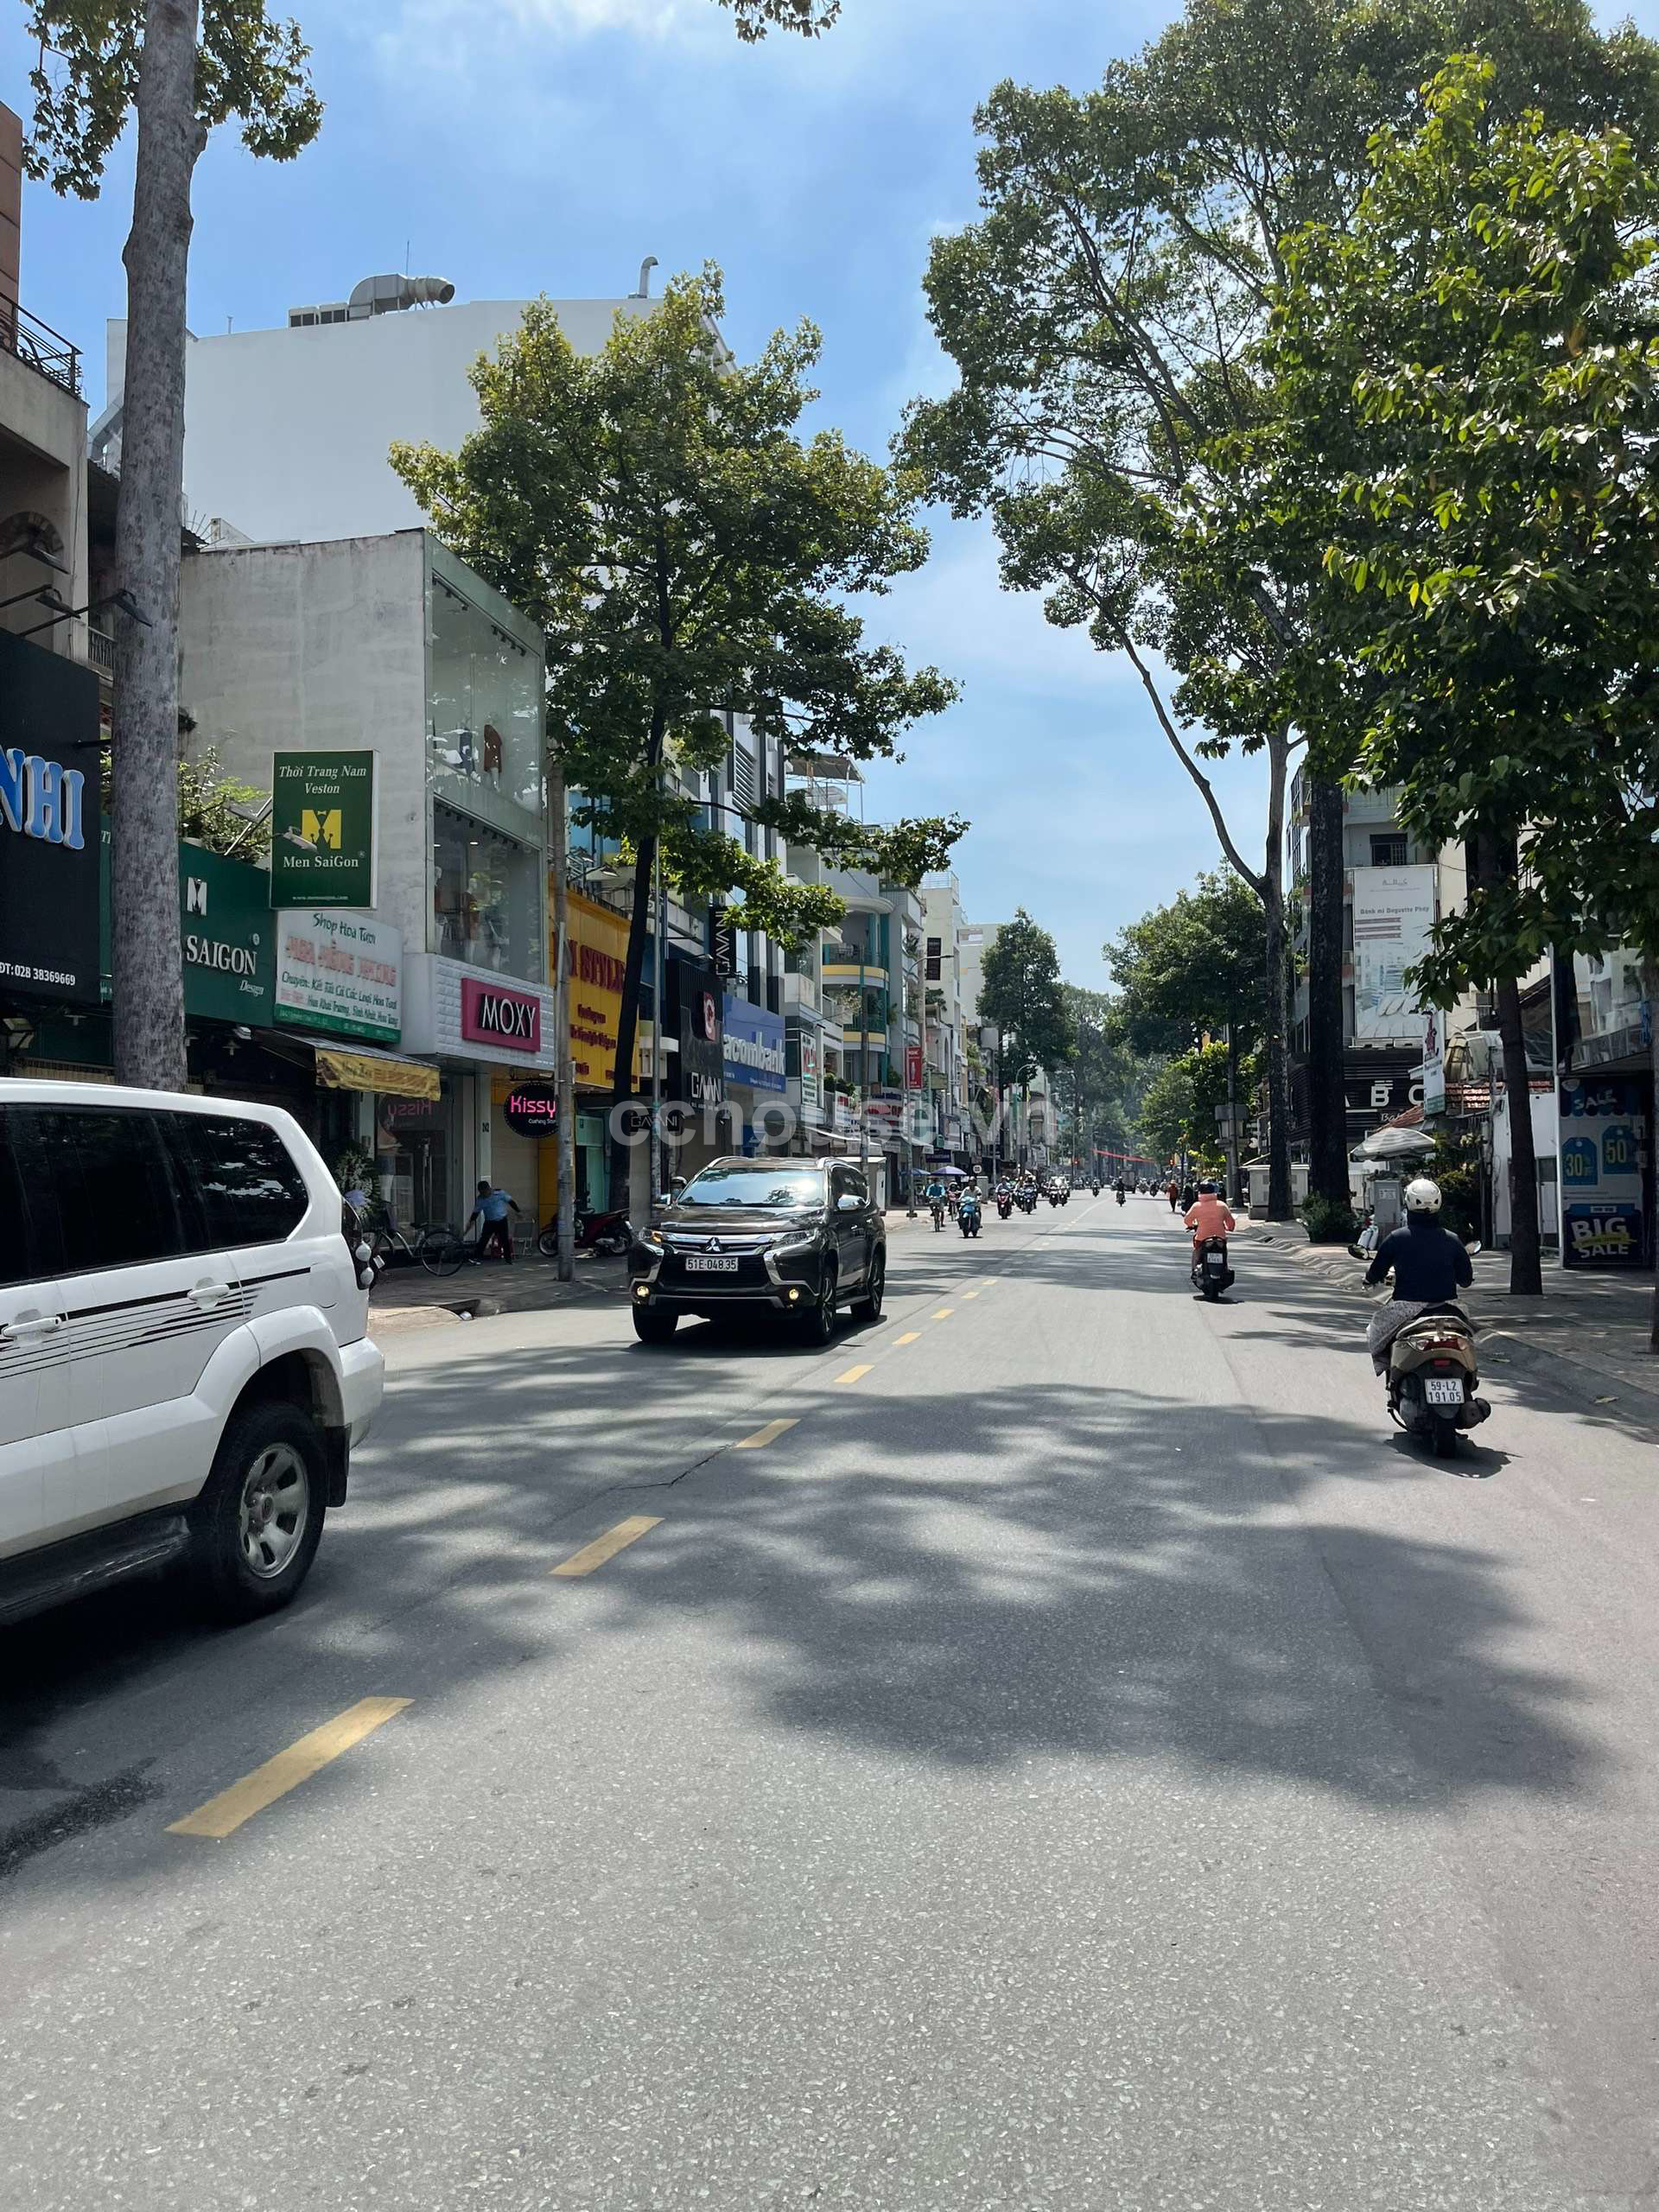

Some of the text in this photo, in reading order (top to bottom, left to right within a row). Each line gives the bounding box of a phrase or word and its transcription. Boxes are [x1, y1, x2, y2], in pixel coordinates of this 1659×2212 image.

[279, 766, 366, 779] Thời Trang Nam
[305, 783, 340, 794] Veston
[283, 855, 359, 868] Men SaiGon
[313, 912, 338, 935] Shop
[340, 921, 357, 939] Hoa
[187, 935, 257, 976] SAIGON
[33, 968, 76, 986] 38369669
[481, 995, 537, 1038] MOXY
[723, 1031, 785, 1076] acombank
[511, 1096, 556, 1118] Kissy
[1573, 1089, 1618, 1110] SALE
[1571, 1217, 1628, 1243] BIG
[1430, 1381, 1457, 1391] 59-L2
